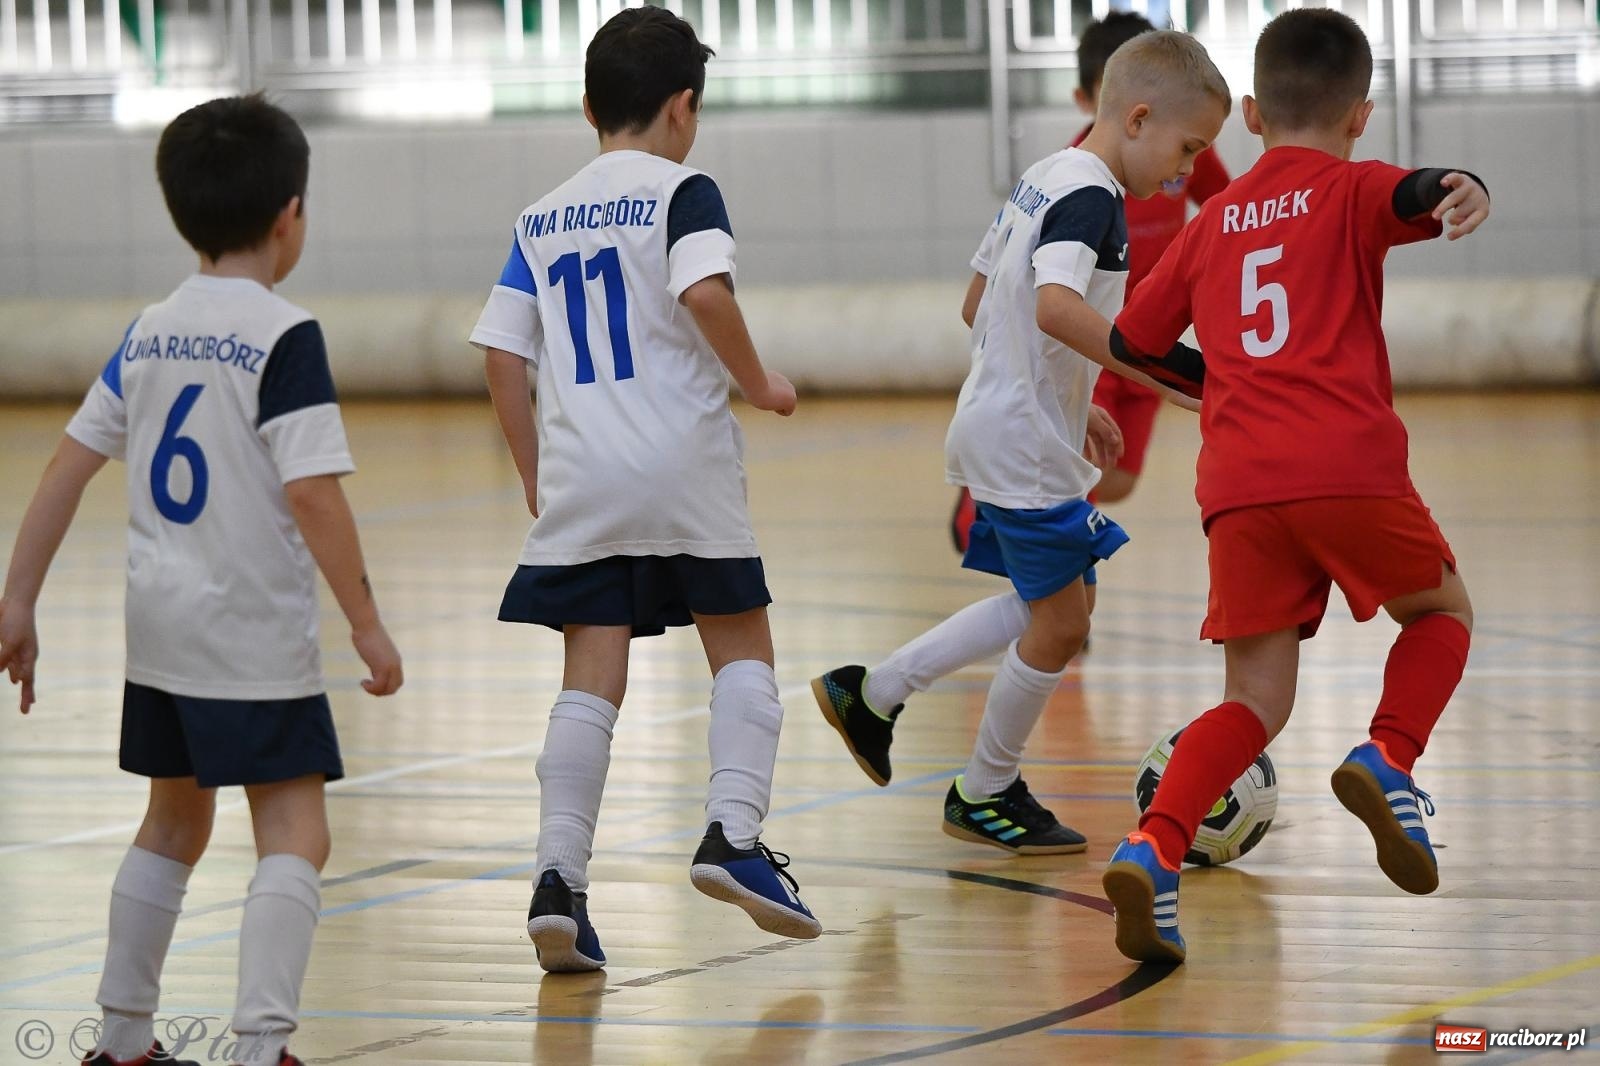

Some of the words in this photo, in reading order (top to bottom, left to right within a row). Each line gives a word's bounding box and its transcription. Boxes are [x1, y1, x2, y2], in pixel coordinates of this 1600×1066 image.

[522, 209, 557, 238] UNA
[1223, 189, 1313, 233] RADEK
[547, 246, 635, 384] 11
[1241, 243, 1290, 358] 5
[165, 333, 266, 374] RACIBÓRZ
[150, 383, 209, 525] 6
